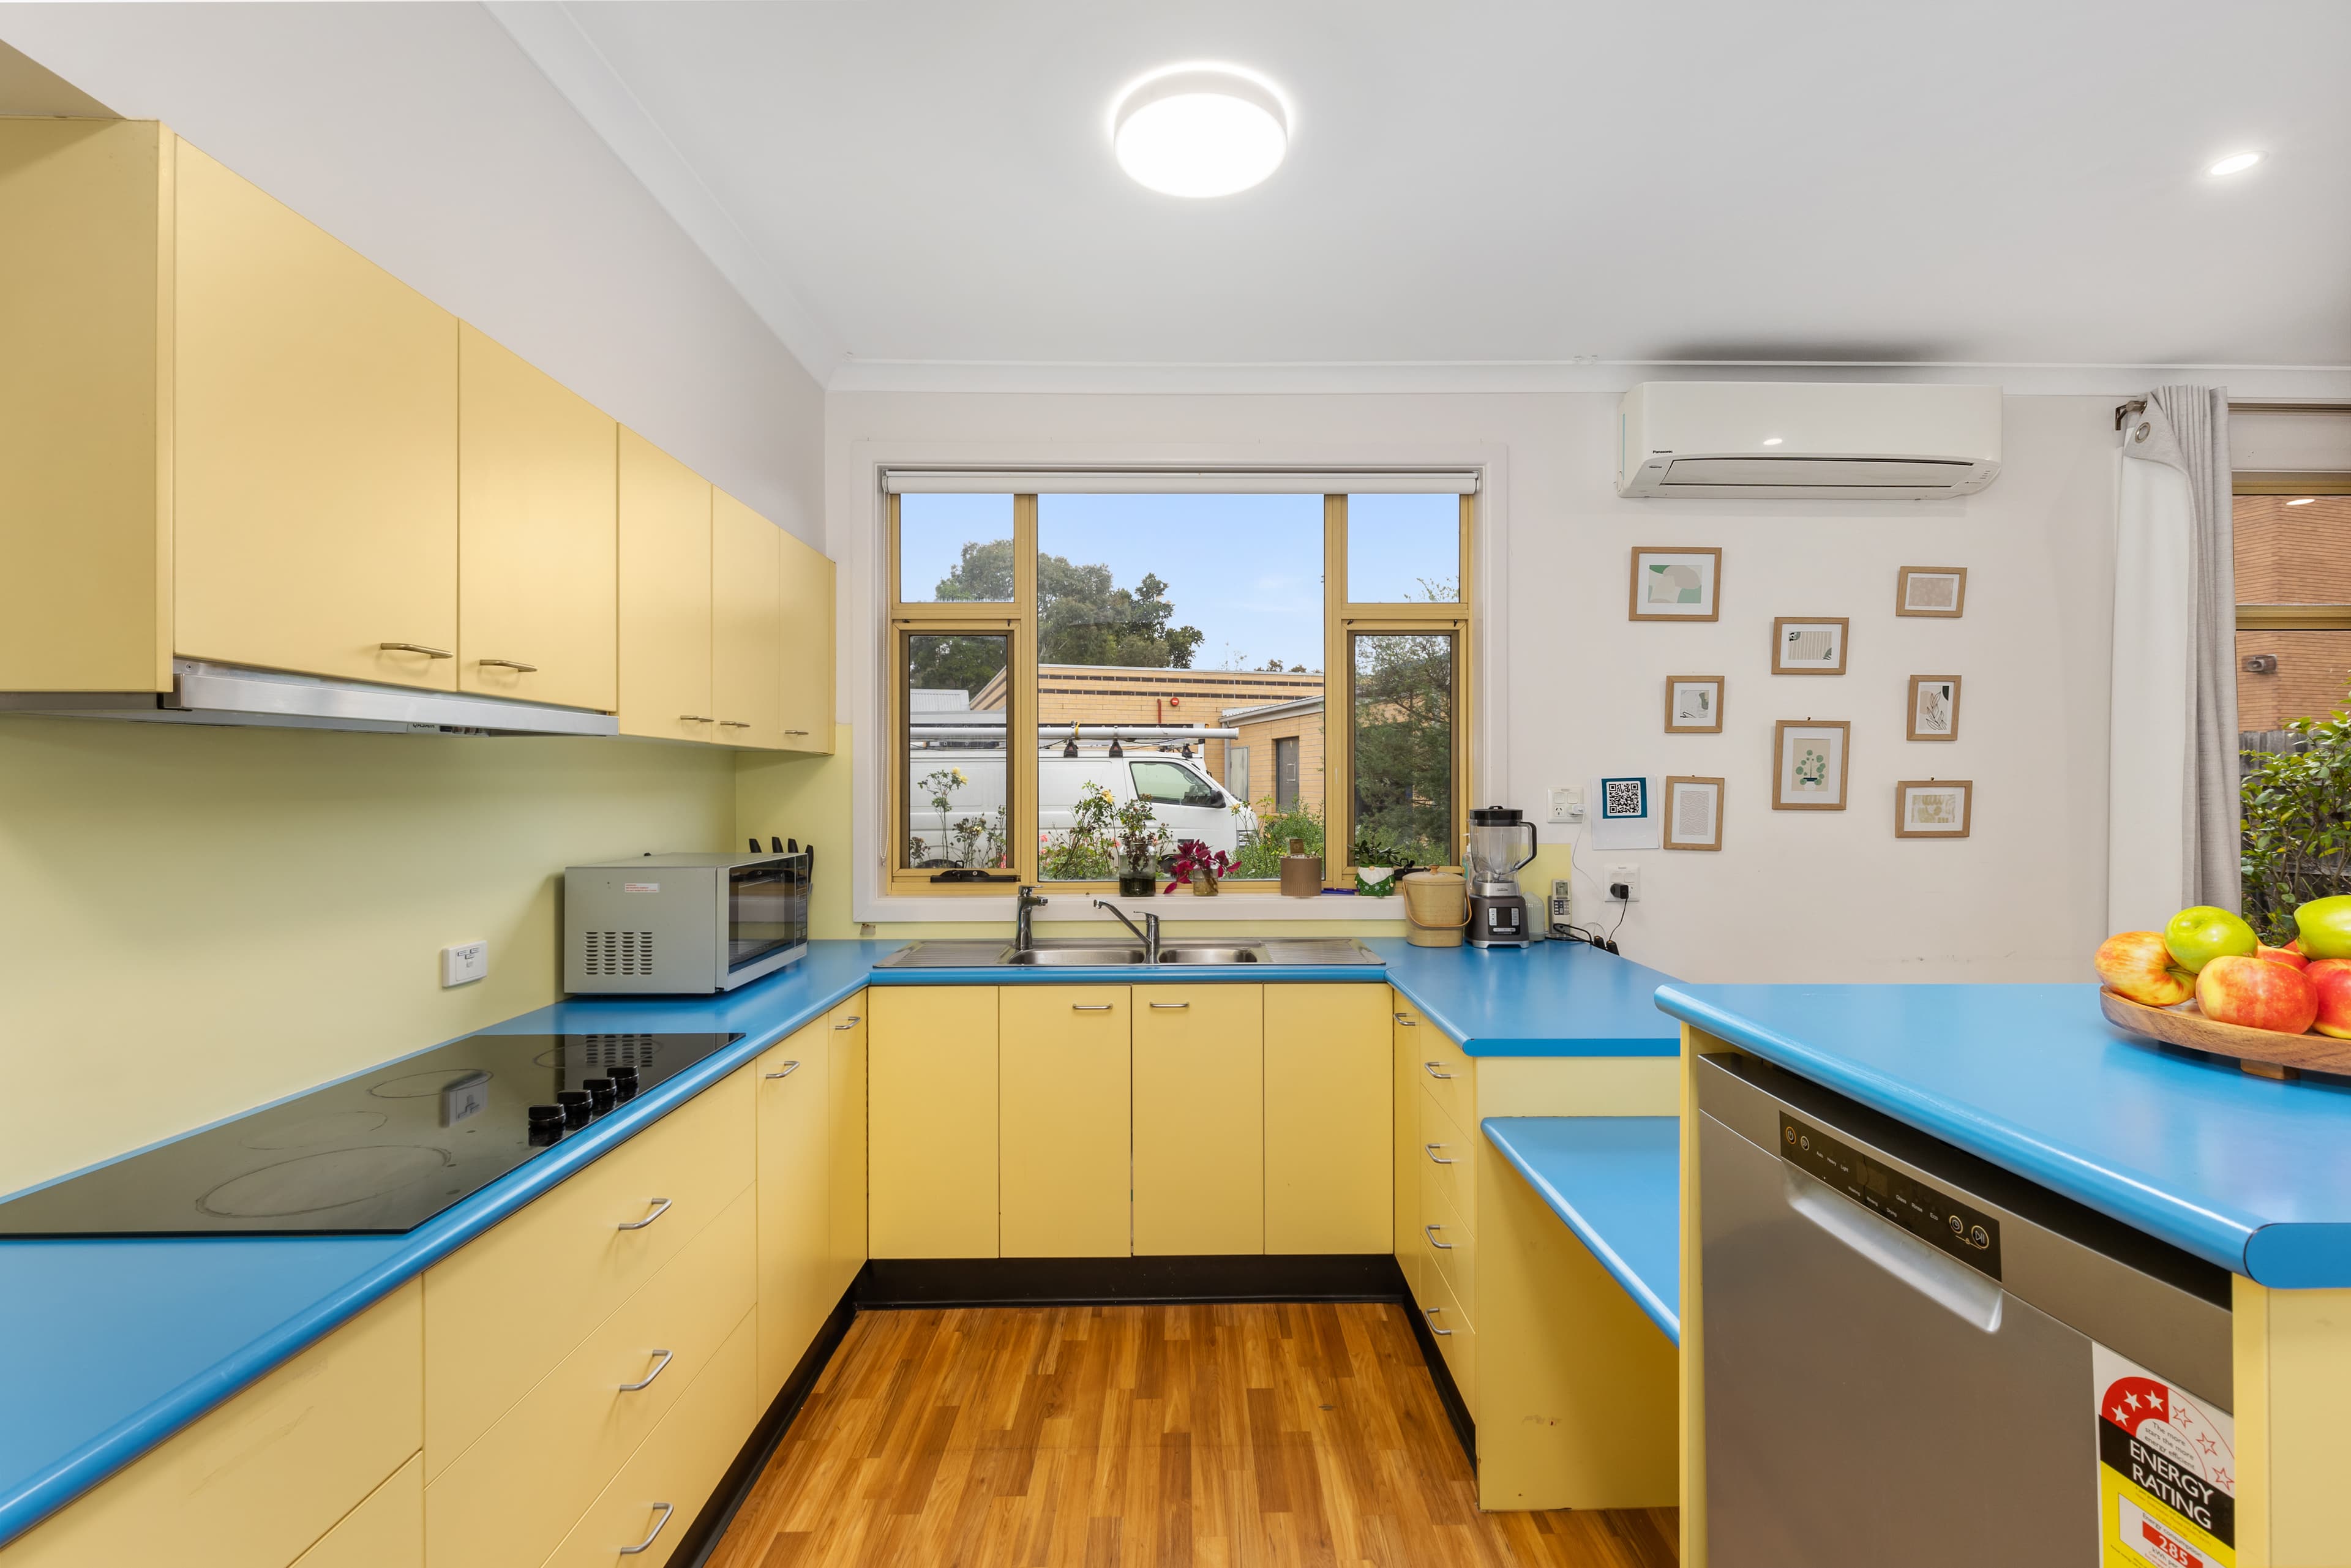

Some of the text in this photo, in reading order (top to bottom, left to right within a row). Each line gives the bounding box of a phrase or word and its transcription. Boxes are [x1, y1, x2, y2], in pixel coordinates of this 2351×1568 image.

[1840, 1164, 1849, 1172] Light
[1929, 1212, 1939, 1221] Eco
[2145, 1427, 2194, 1460] stars the more
[2152, 1420, 2186, 1446] The more
[2145, 1436, 2195, 1470] energy efficient
[2130, 1439, 2214, 1505] ENERGY
[2132, 1463, 2211, 1529] RATING
[2142, 1512, 2162, 1531] Energy
[2163, 1528, 2202, 1558] consumption
[2159, 1535, 2188, 1566] 285
[2152, 1547, 2167, 1561] kWh
